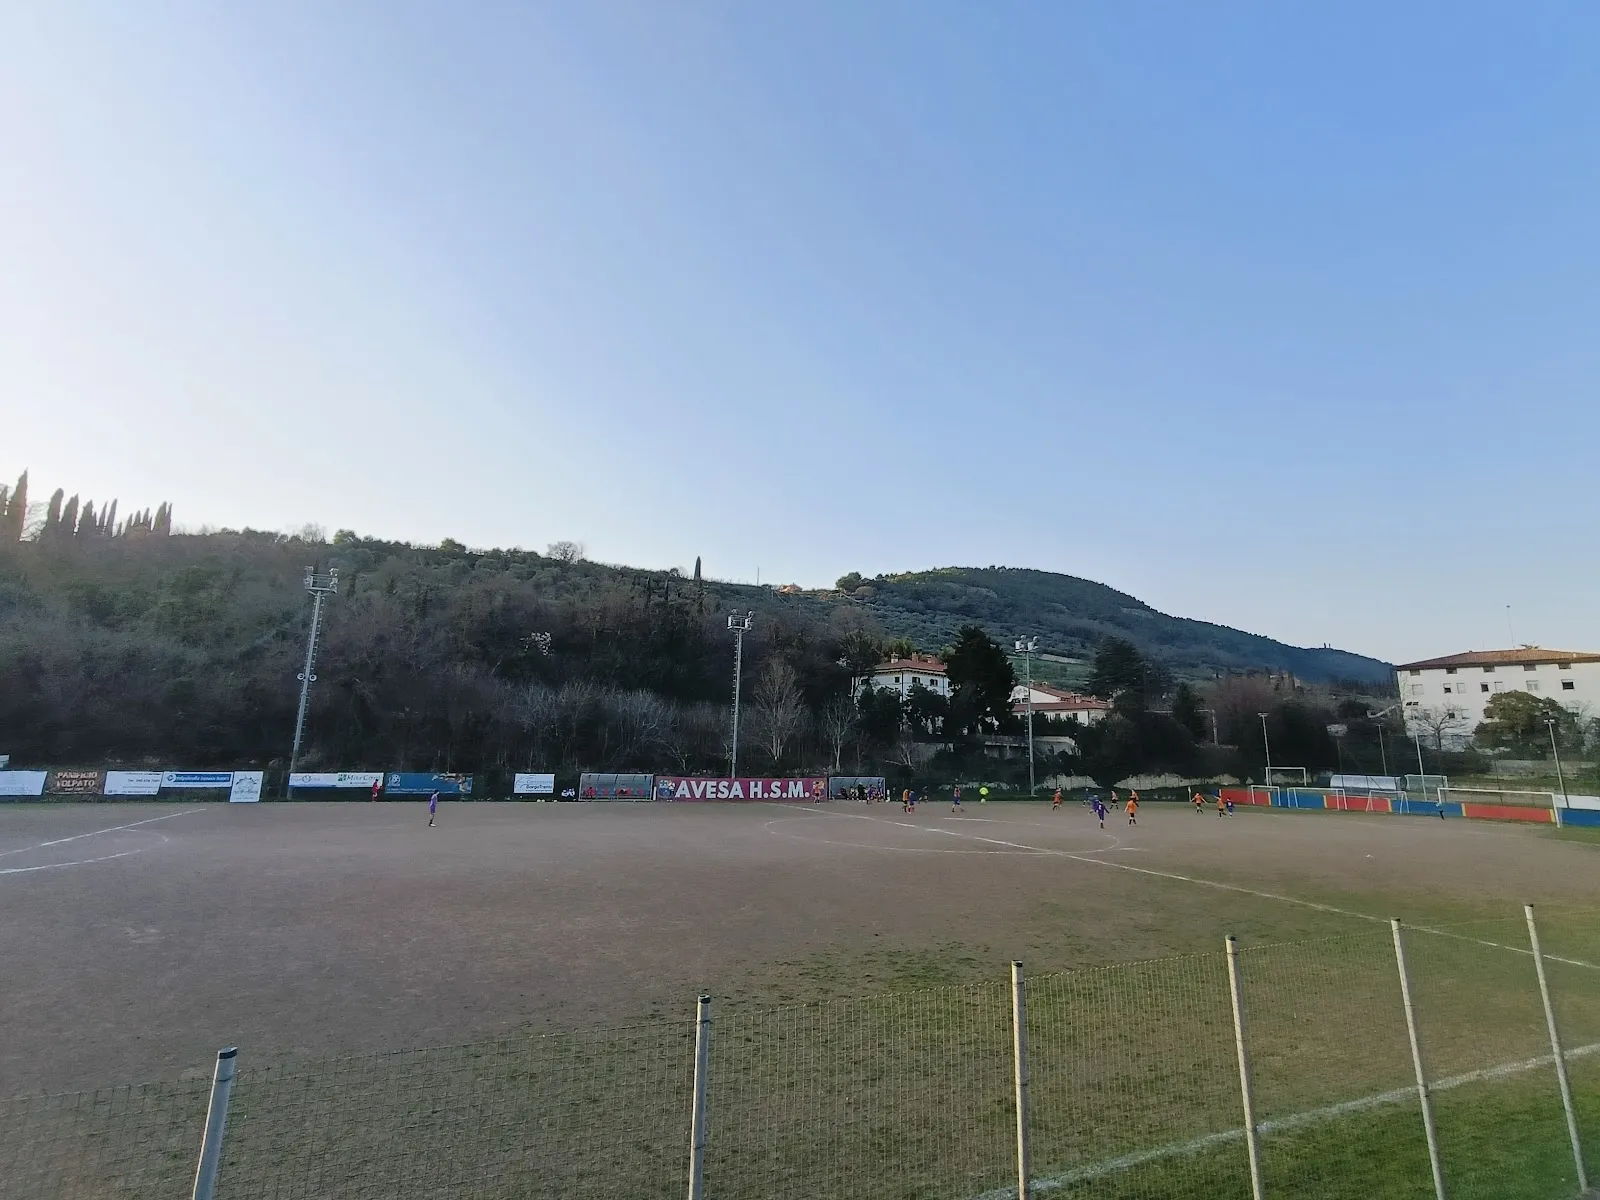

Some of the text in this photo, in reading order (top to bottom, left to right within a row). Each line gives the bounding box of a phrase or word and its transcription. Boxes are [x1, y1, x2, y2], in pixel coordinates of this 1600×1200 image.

[56, 779, 95, 787] VOLPATO
[675, 780, 810, 799] AVESA H.S.M.
